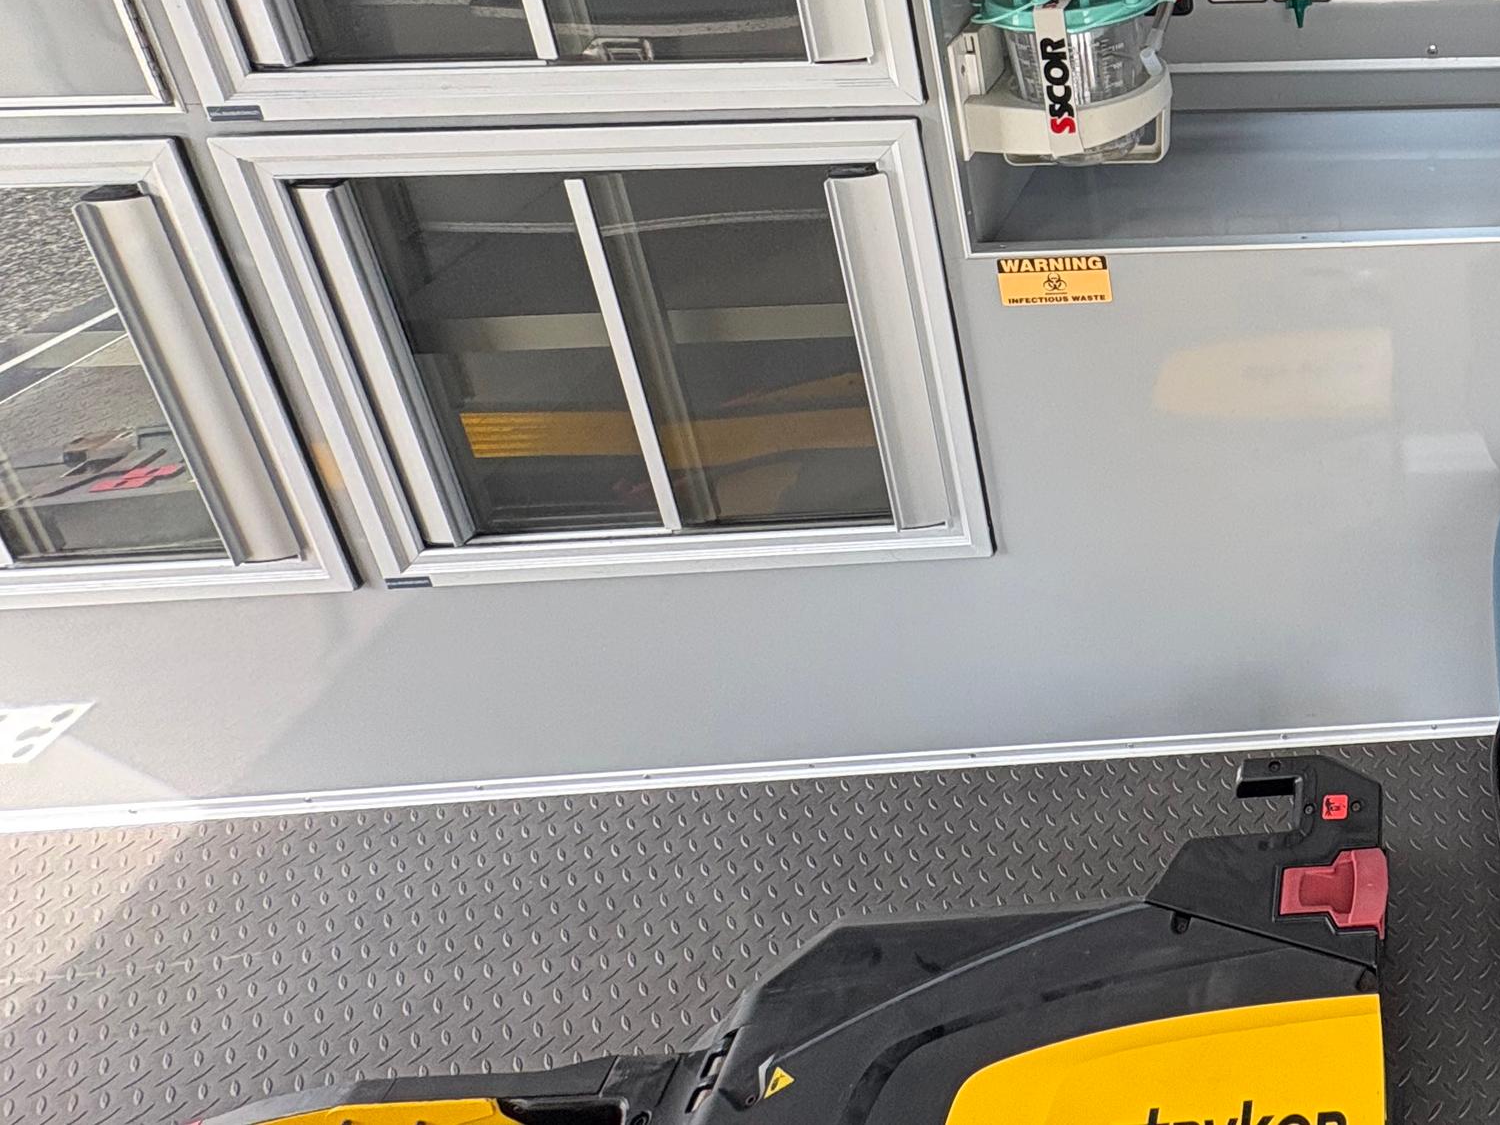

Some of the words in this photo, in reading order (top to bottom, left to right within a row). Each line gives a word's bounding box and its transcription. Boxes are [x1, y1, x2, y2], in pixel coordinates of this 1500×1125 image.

[1040, 37, 1076, 134] SSCOR
[1000, 256, 1103, 273] WARNING
[1008, 295, 1069, 304] INFECTIOUS
[1072, 294, 1106, 302] WASTE
